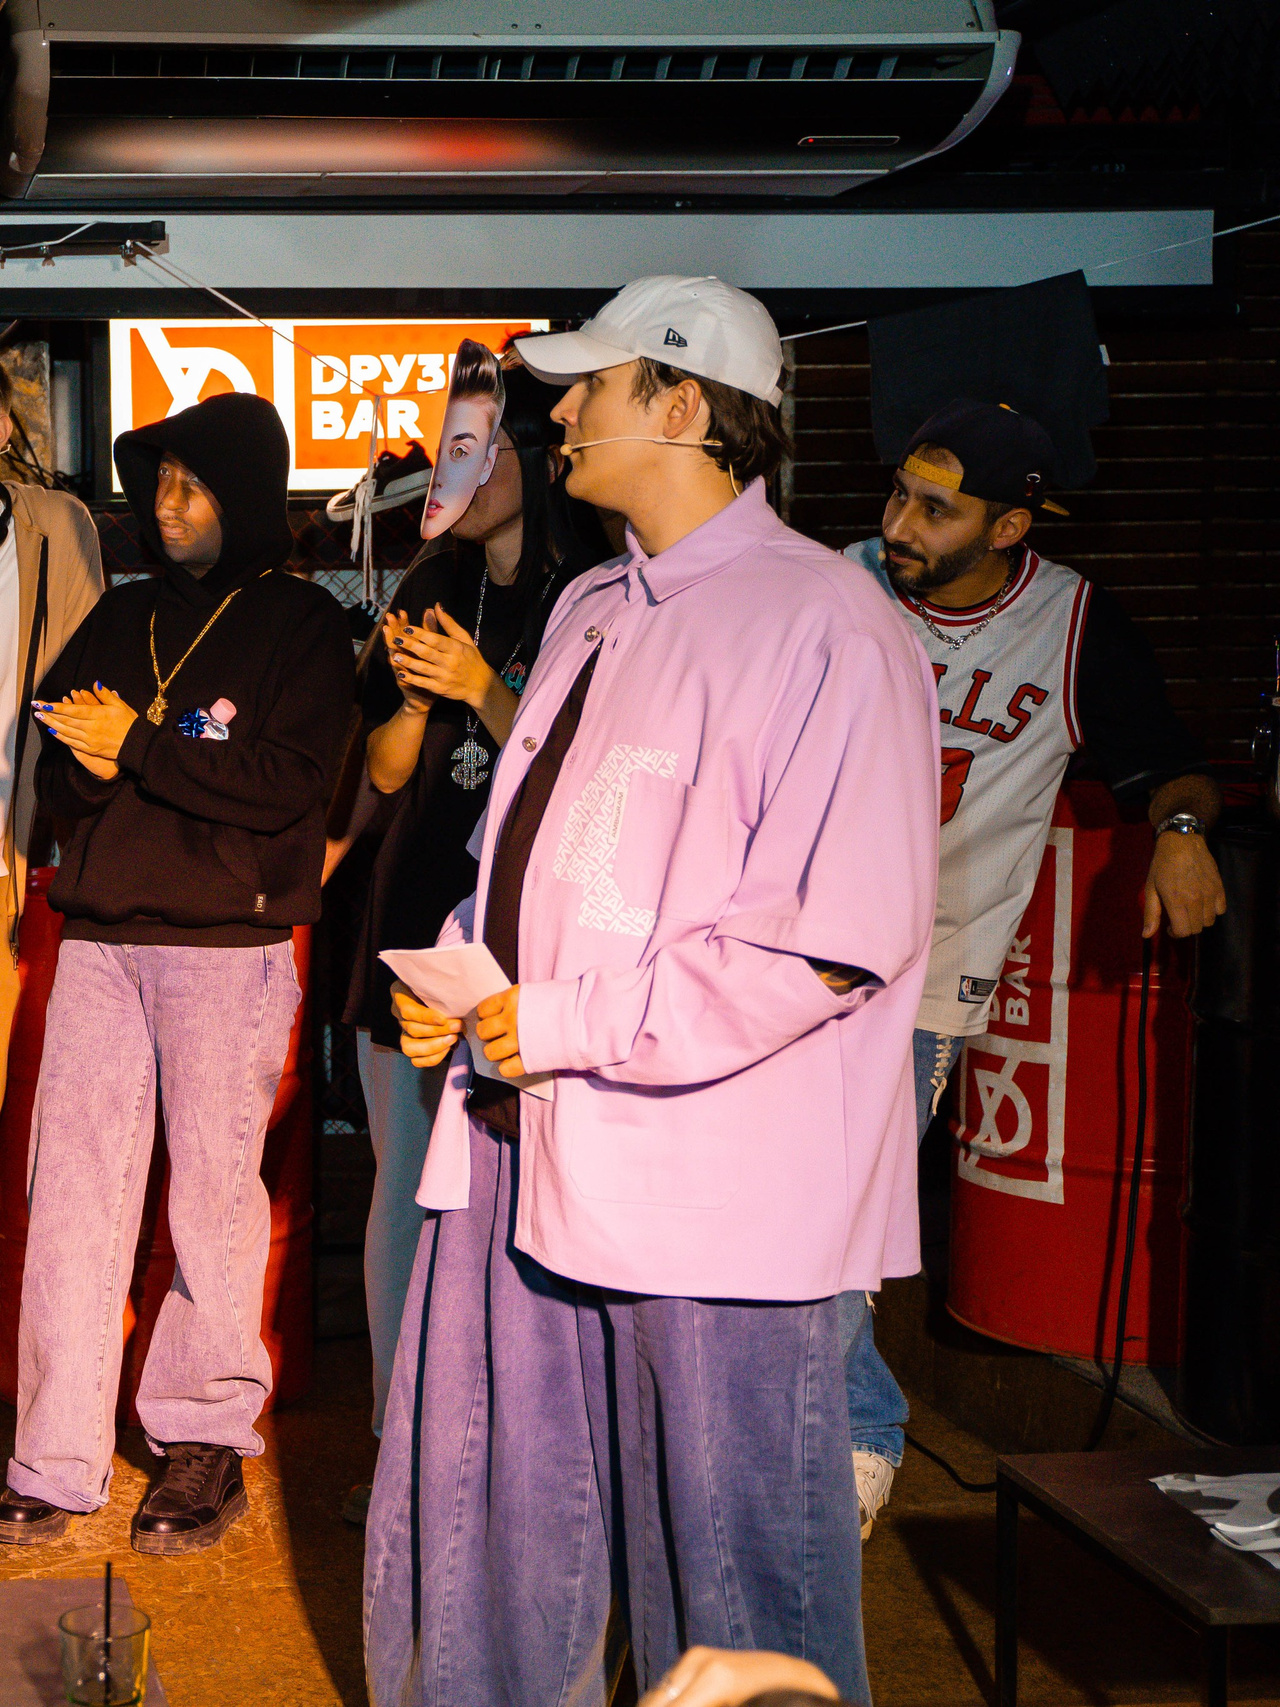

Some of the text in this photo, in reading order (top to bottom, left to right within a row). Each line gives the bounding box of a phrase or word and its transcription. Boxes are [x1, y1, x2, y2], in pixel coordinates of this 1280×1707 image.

[311, 353, 457, 395] DРУЗ
[311, 399, 424, 440] BAR
[1004, 933, 1031, 1026] BAR
